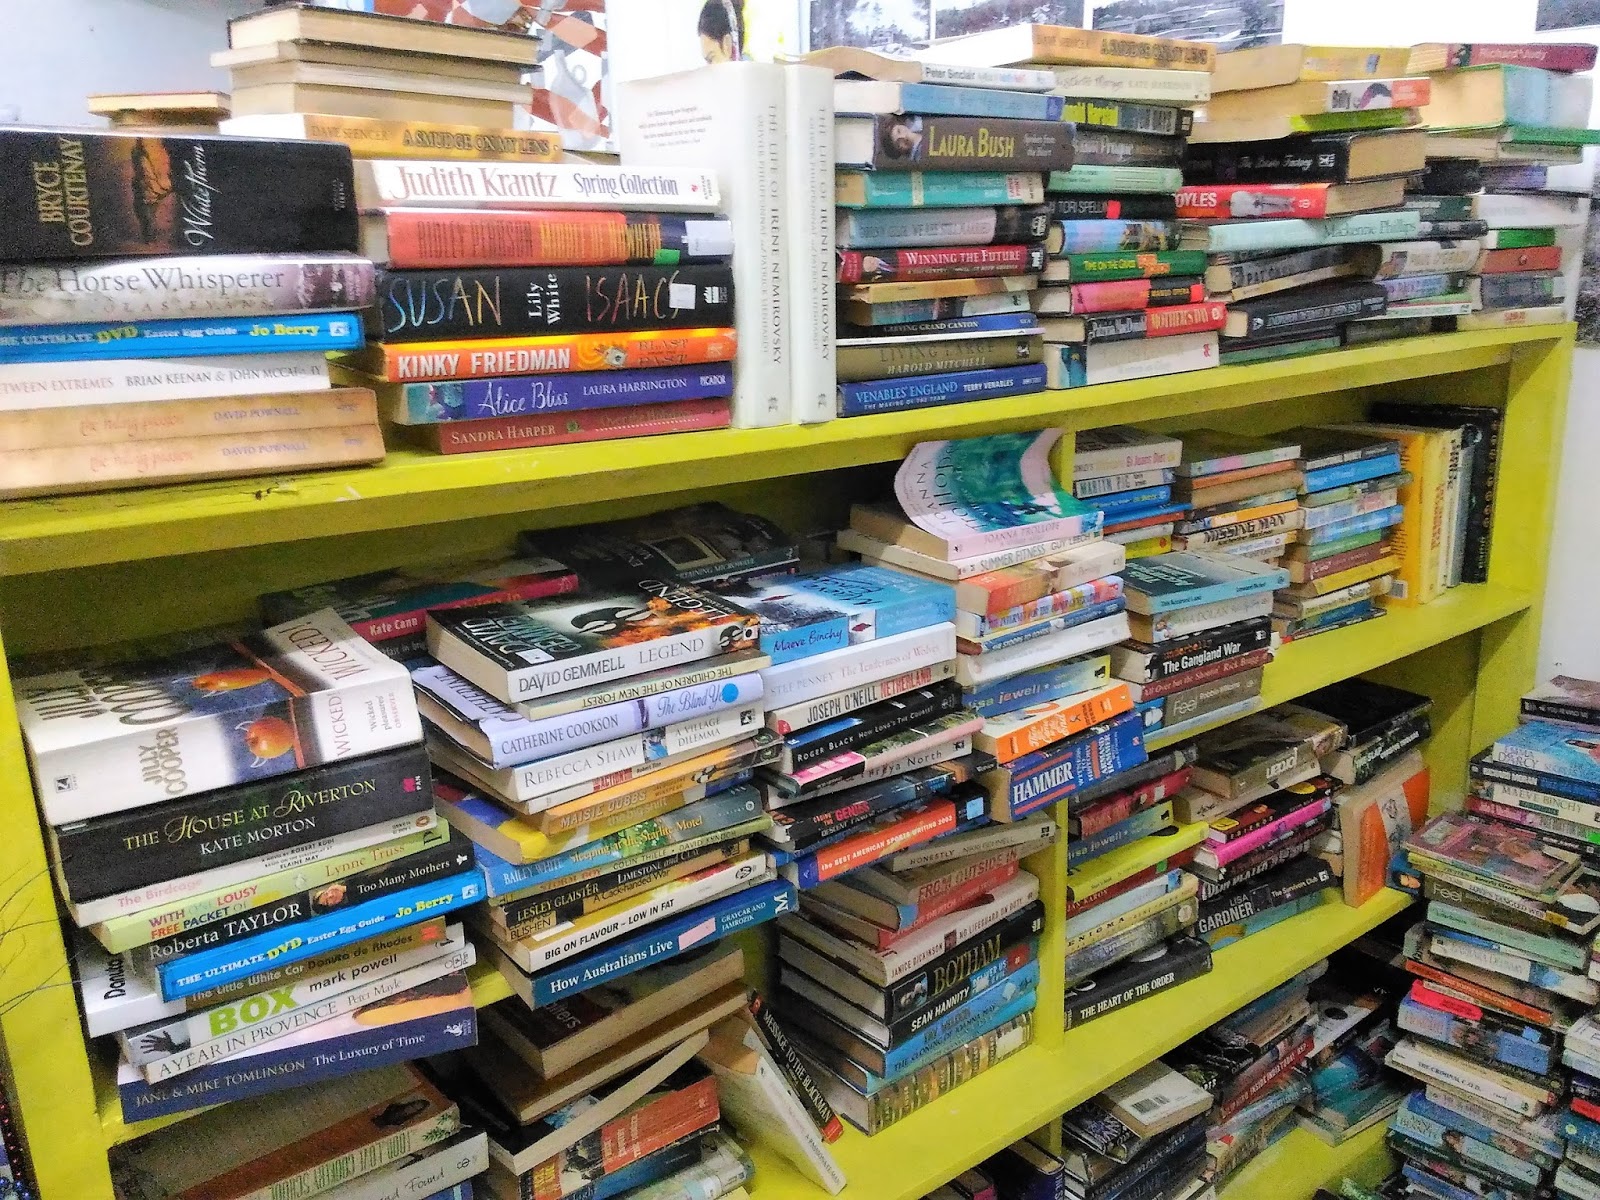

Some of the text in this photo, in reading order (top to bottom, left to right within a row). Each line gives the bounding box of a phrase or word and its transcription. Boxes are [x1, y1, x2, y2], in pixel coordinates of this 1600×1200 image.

[928, 125, 1015, 158] LAURA BUSH
[33, 160, 66, 223] BRYCE
[388, 167, 562, 200] Judith Krantz
[574, 172, 617, 199] Spring
[619, 172, 679, 197] Collection
[905, 249, 1022, 266] WINNING THE FUTURE
[52, 262, 286, 296] Horse Whisperer
[388, 274, 502, 334] SUSAN
[95, 322, 320, 345] DVD Jo Berry
[126, 372, 163, 388] BRIAN
[165, 369, 213, 385] KEENAN
[399, 348, 571, 380] KINKY FRIEDMAN
[887, 356, 987, 375] HAROLD MITCHELL
[478, 382, 569, 417] Alice Bliss
[583, 383, 617, 396] LAURA
[618, 377, 688, 393] HARRINGTON
[909, 381, 958, 396] ENGLAND
[451, 423, 556, 446] SANDRA HARPER
[1204, 519, 1255, 543] MISSING
[980, 553, 1014, 571] SUMMER
[1014, 545, 1046, 565] FITNESS
[369, 619, 393, 636] Kate
[773, 633, 806, 653] Maeve
[519, 637, 705, 694] DAVID GEMMELL LEGEND
[1162, 641, 1242, 676] The Gangland War
[806, 666, 932, 724] JOSEPH O'NEILL NETHERLAND
[1000, 683, 1042, 705] jewell
[326, 691, 352, 758] WICKED!
[501, 714, 619, 756] CATHERINE COOKSON
[677, 728, 722, 748] DILEMMA
[140, 743, 158, 787] JILLY
[156, 726, 189, 796] COOPER
[523, 743, 639, 788] REBECCA SHAW
[797, 735, 855, 763] ROGER BLACK
[907, 751, 943, 767] North
[1013, 761, 1074, 805] HAMMER
[124, 778, 378, 851] THE HOUSE RIVERTON
[559, 803, 604, 829] MAISIE
[673, 815, 704, 833] Motel
[200, 816, 318, 857] KATE MORTON
[851, 840, 886, 860] AMERICAN
[149, 883, 260, 928] WITH LOUSY
[150, 857, 451, 961] Roberta TAYLOR Too Many Mothers
[516, 864, 662, 923] LESLEY GLAISTER LIMESTONE
[1228, 893, 1250, 908] LISA
[1433, 883, 1463, 902] Feel
[150, 907, 231, 940] FREE PACKET
[510, 920, 552, 941] BLISHEN
[544, 898, 676, 961] BIG ON FLAVOUR LOW FAT
[1198, 900, 1254, 934] GARDNER
[176, 892, 454, 988] THE ULTIMATE DVD Easter Guide Jo Berry
[549, 938, 674, 994] How Australians Live
[933, 934, 1001, 997] BOTHAM
[209, 952, 399, 1037] BOX mark powell
[910, 986, 970, 1033] SEAN HANNITY
[1080, 971, 1175, 1020] THE HEART THE ORDER
[158, 1000, 340, 1078] A YEAR IN PROVENCE
[186, 1078, 221, 1098] MIKE
[225, 1058, 308, 1088] TOMLINSON
[312, 1053, 337, 1067] The
[338, 1040, 380, 1066] Luxury
[762, 1008, 833, 1124] MESSAGE TO THE BLACKMAN
[405, 1166, 446, 1193] Found
